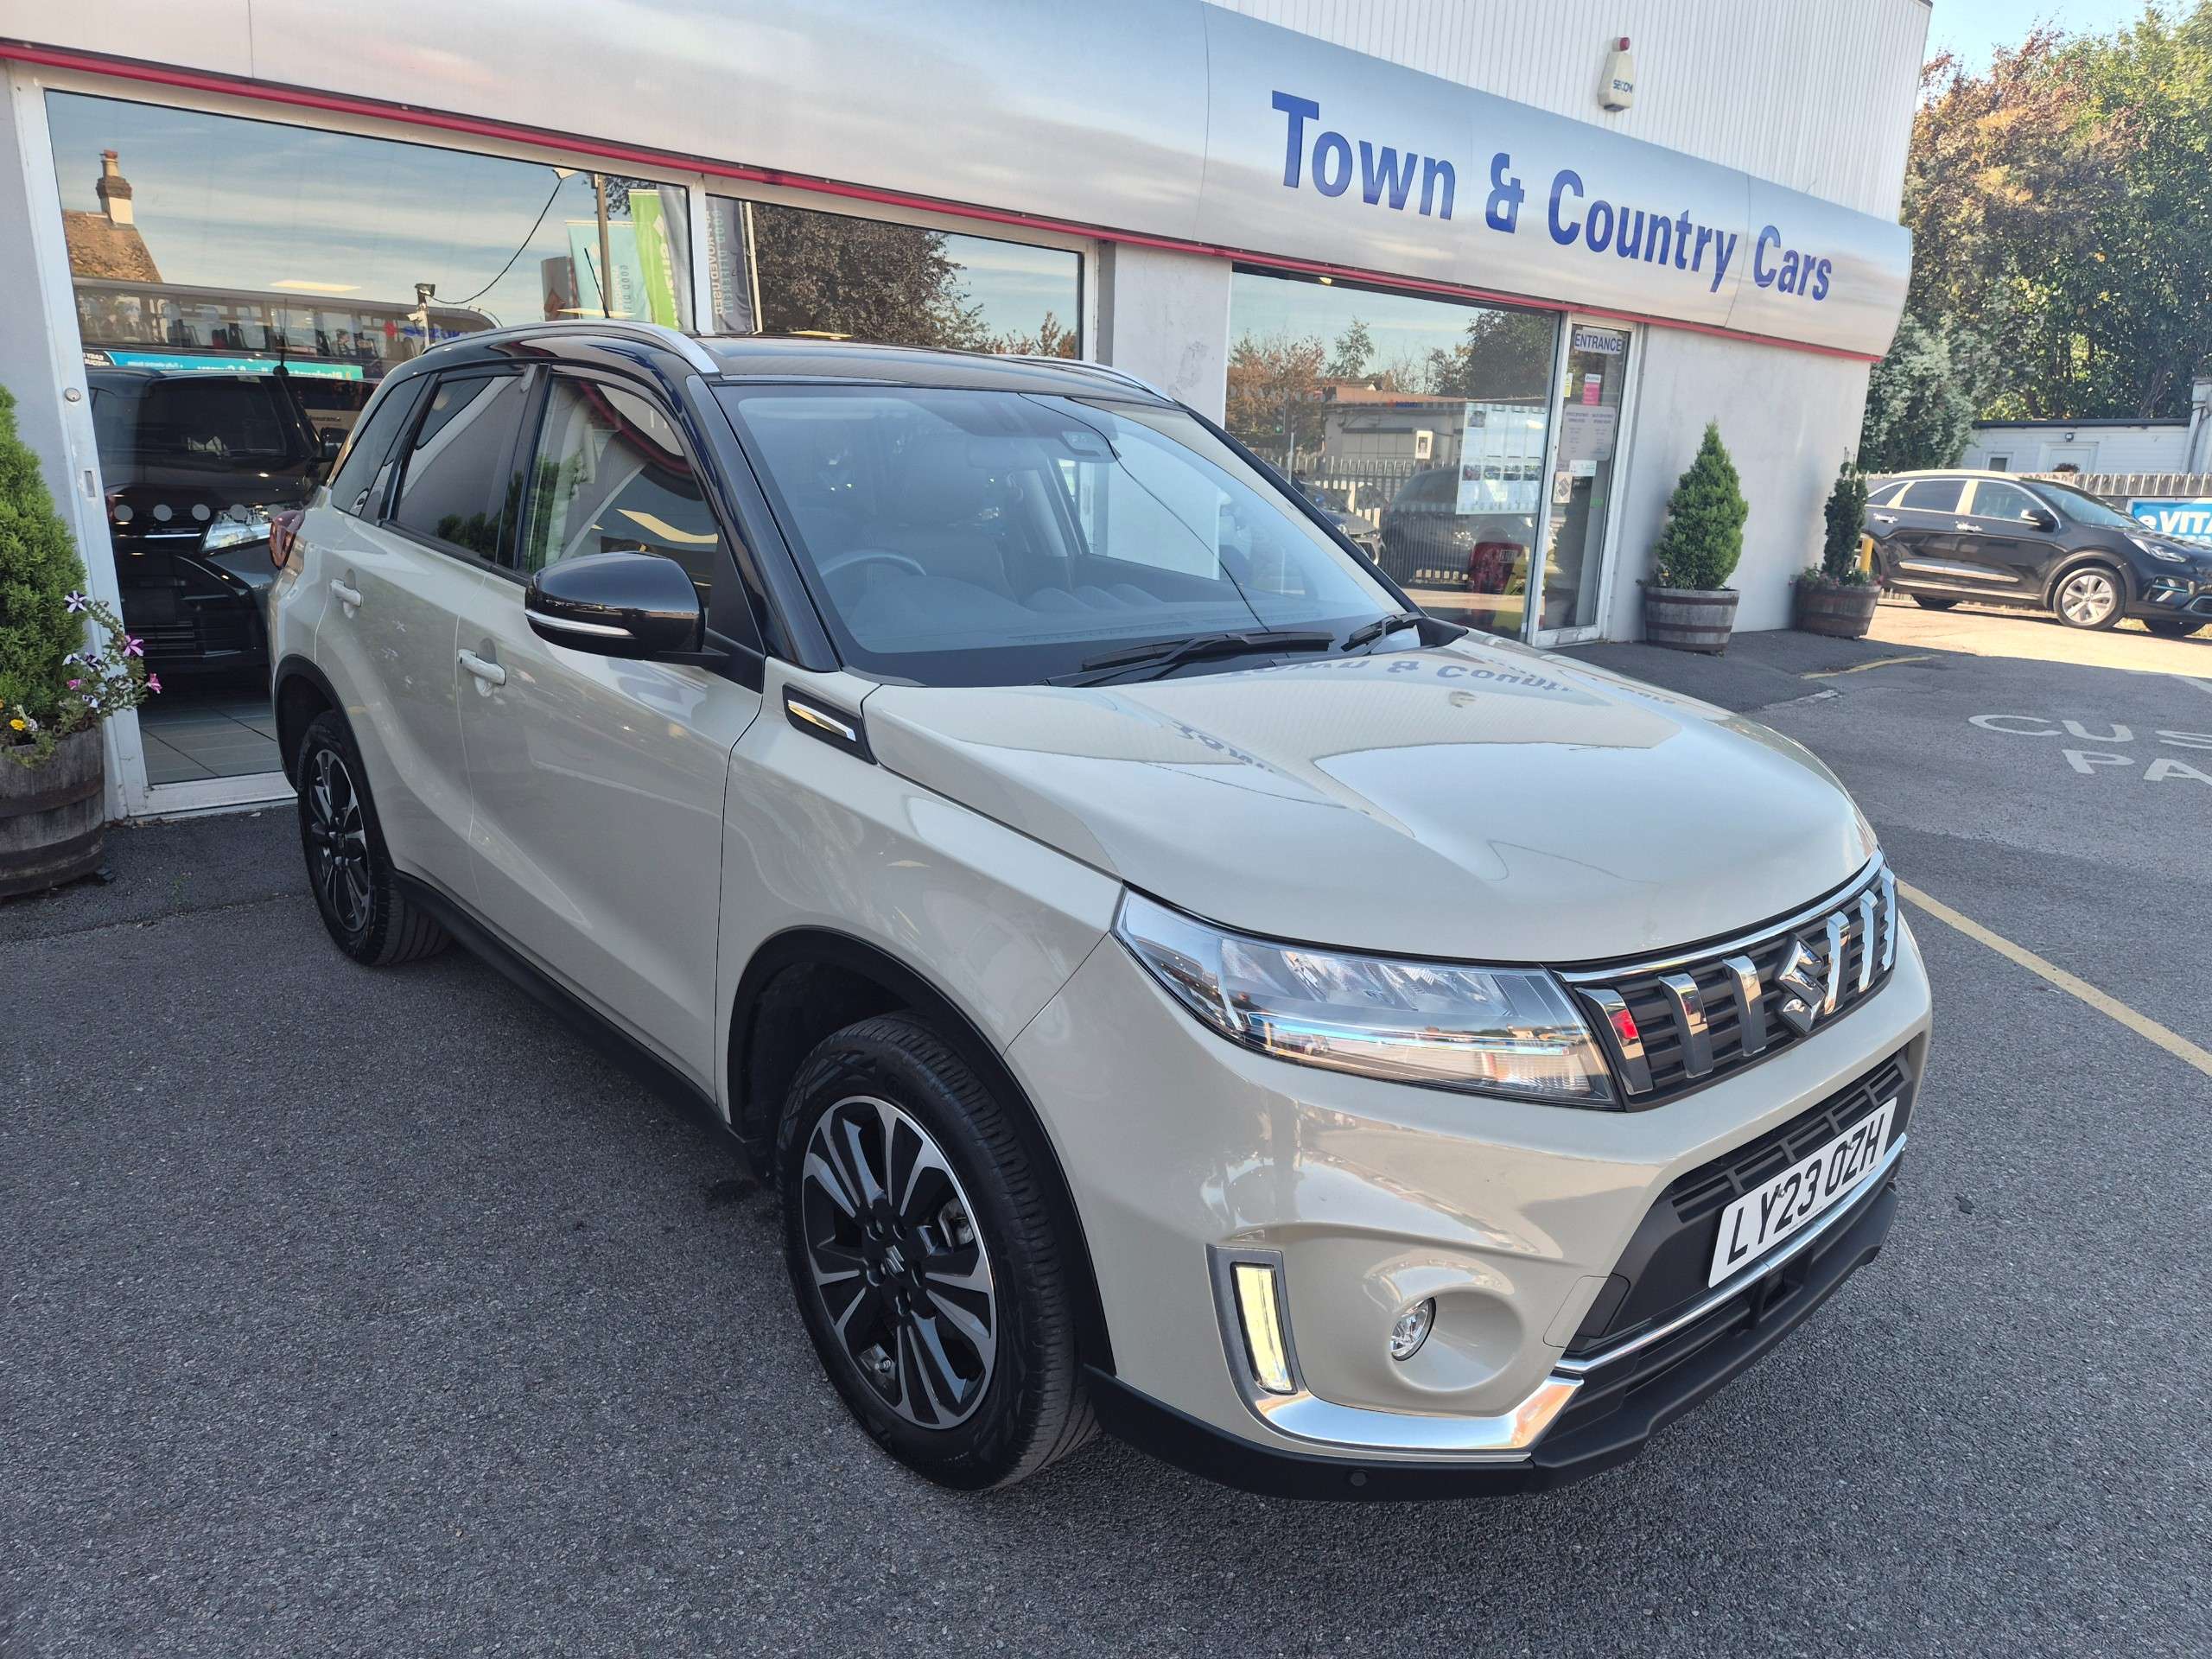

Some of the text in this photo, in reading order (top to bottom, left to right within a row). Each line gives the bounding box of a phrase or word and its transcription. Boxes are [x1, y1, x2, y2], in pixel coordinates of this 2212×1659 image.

[1272, 91, 1832, 301] Town & Country Cars
[1575, 334, 1622, 352] ENTRANCE
[1727, 1113, 1885, 1266] LY23 OZH
